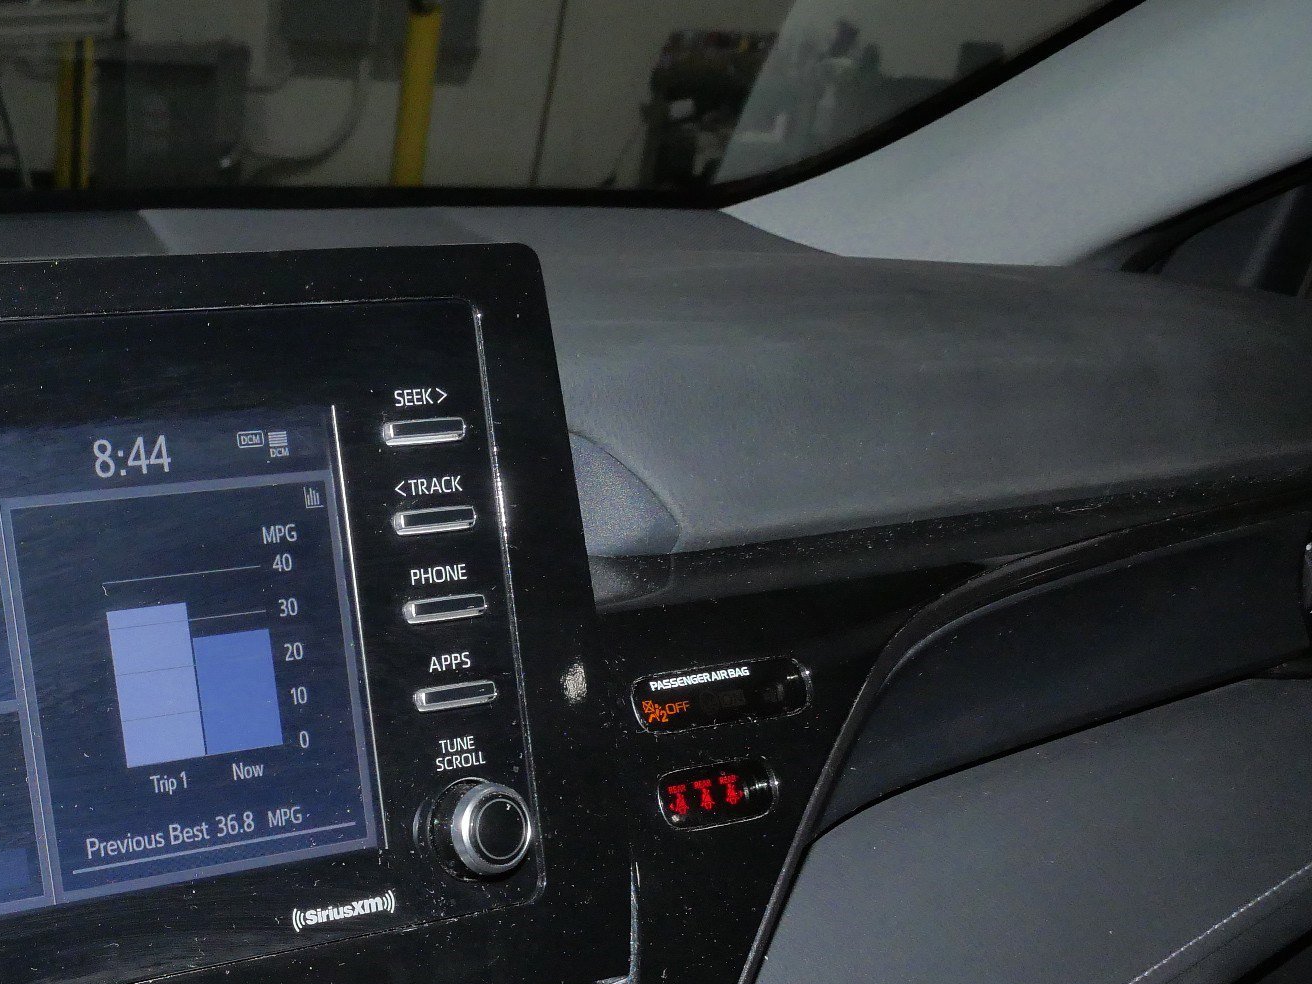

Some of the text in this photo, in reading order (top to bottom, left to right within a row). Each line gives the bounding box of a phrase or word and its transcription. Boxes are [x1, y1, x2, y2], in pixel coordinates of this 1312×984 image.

[240, 434, 261, 446] DCM
[92, 434, 172, 478] 8:44
[270, 448, 289, 458] DCM
[261, 523, 298, 545] MPG
[272, 553, 292, 572] 40
[410, 564, 468, 586] PHONE
[278, 598, 298, 617] 30
[284, 642, 304, 662] 20
[429, 652, 471, 673] APPS
[649, 672, 712, 692] PASSENGER
[291, 686, 307, 705] 10
[666, 700, 691, 716] OFF
[299, 730, 310, 749] 0
[439, 736, 475, 753] TUNE
[436, 751, 486, 772] SCROLL
[232, 762, 264, 781] Now
[149, 771, 188, 796] Trip 1
[86, 806, 303, 859] Previous Best 36.8 MPG
